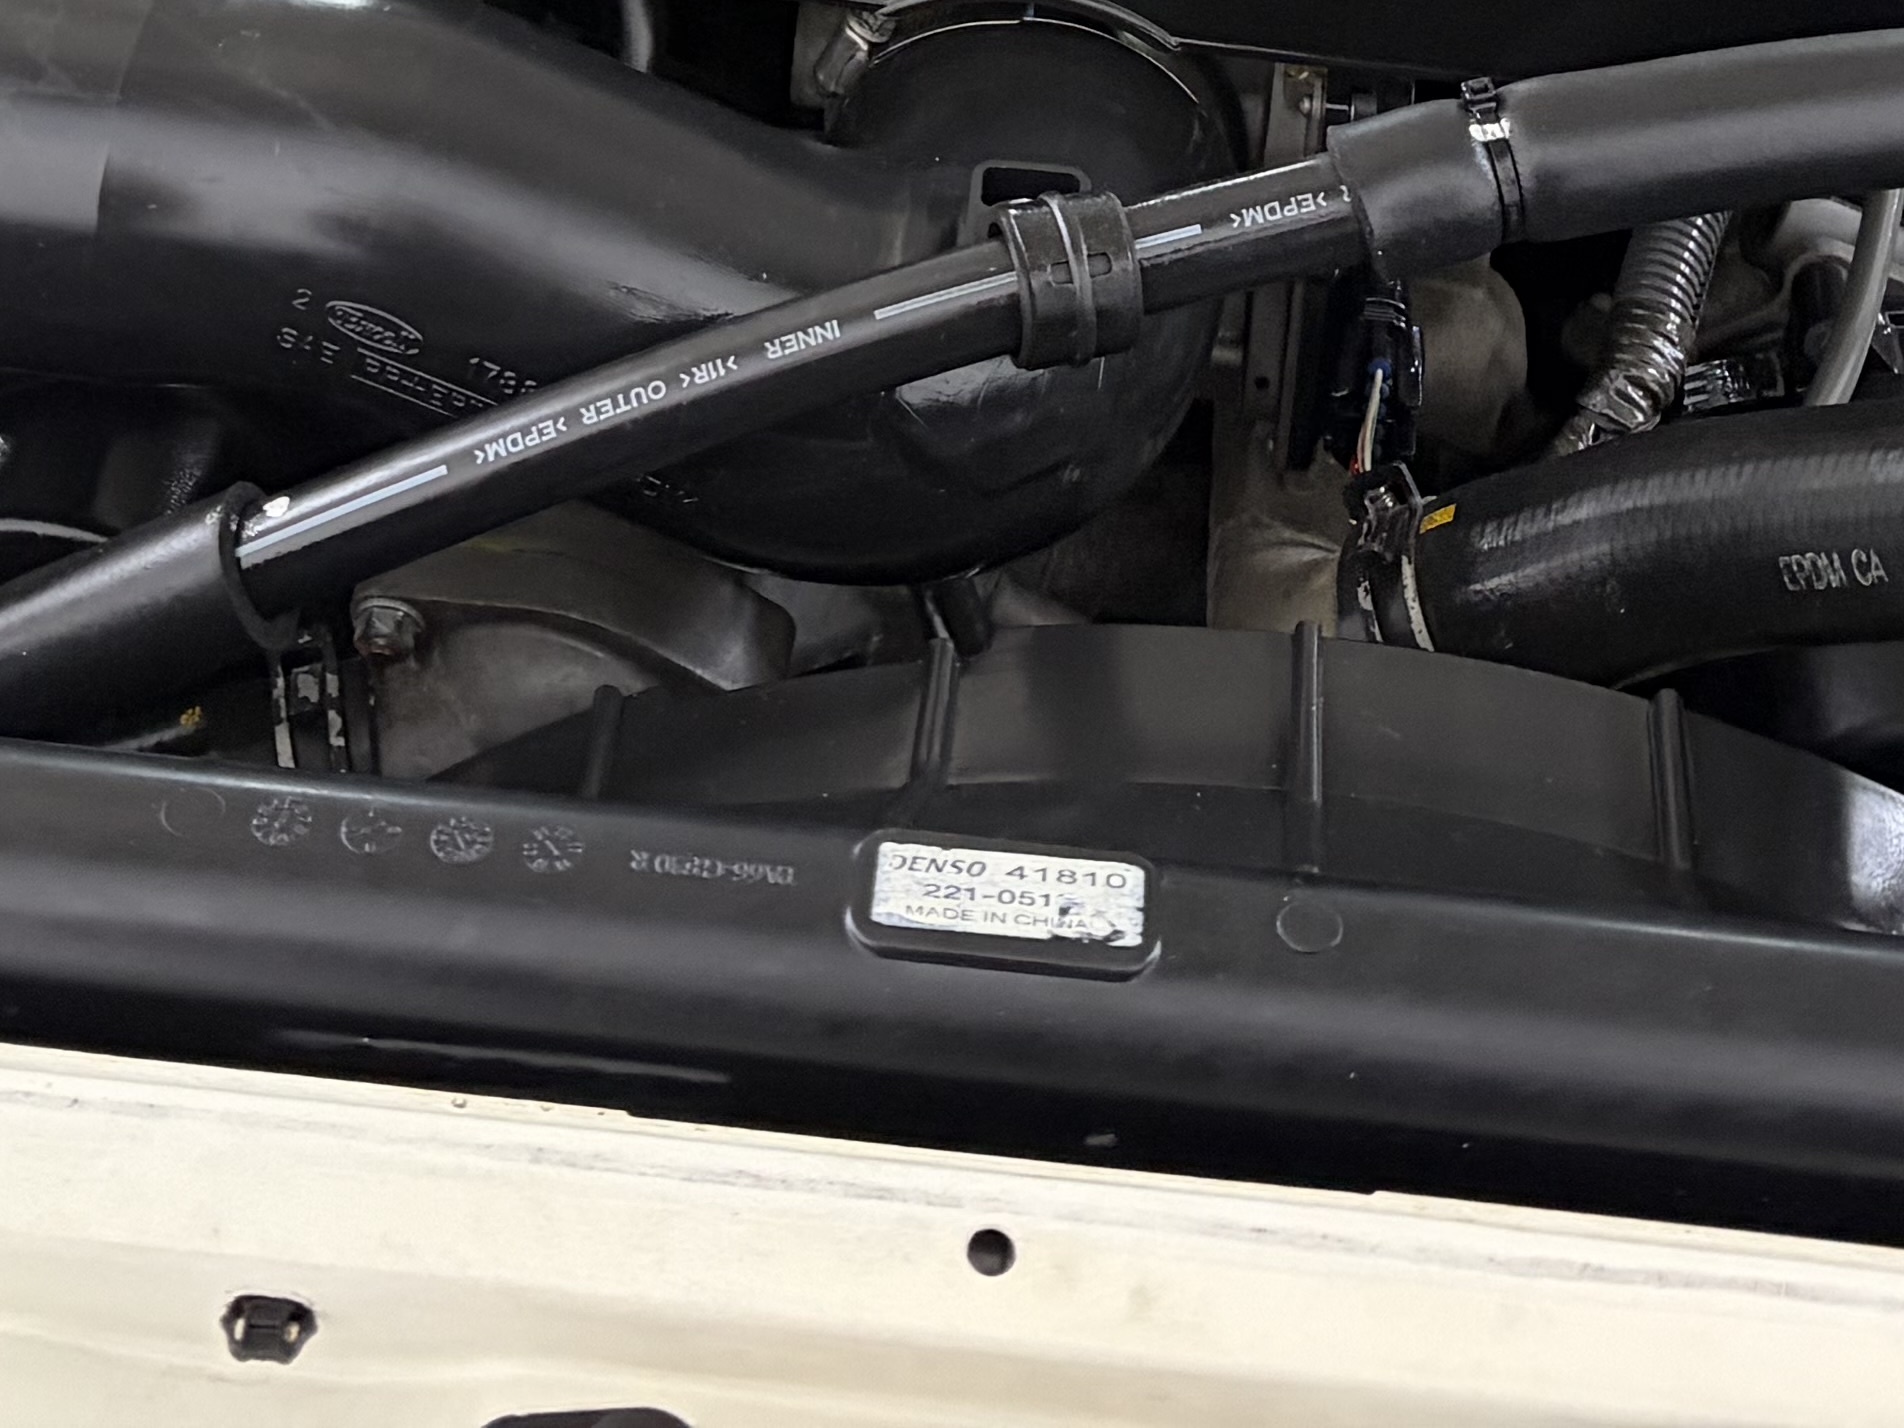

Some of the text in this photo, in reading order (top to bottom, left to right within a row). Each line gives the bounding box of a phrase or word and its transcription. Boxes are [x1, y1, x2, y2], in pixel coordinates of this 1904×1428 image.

[763, 319, 841, 360] INNER
[579, 379, 667, 426] OUTER
[1851, 547, 1889, 587] CA
[889, 854, 1127, 889] DENSO 41810
[922, 883, 1064, 907] 221-051
[905, 904, 977, 922] MADE
[983, 911, 1007, 924] IN
